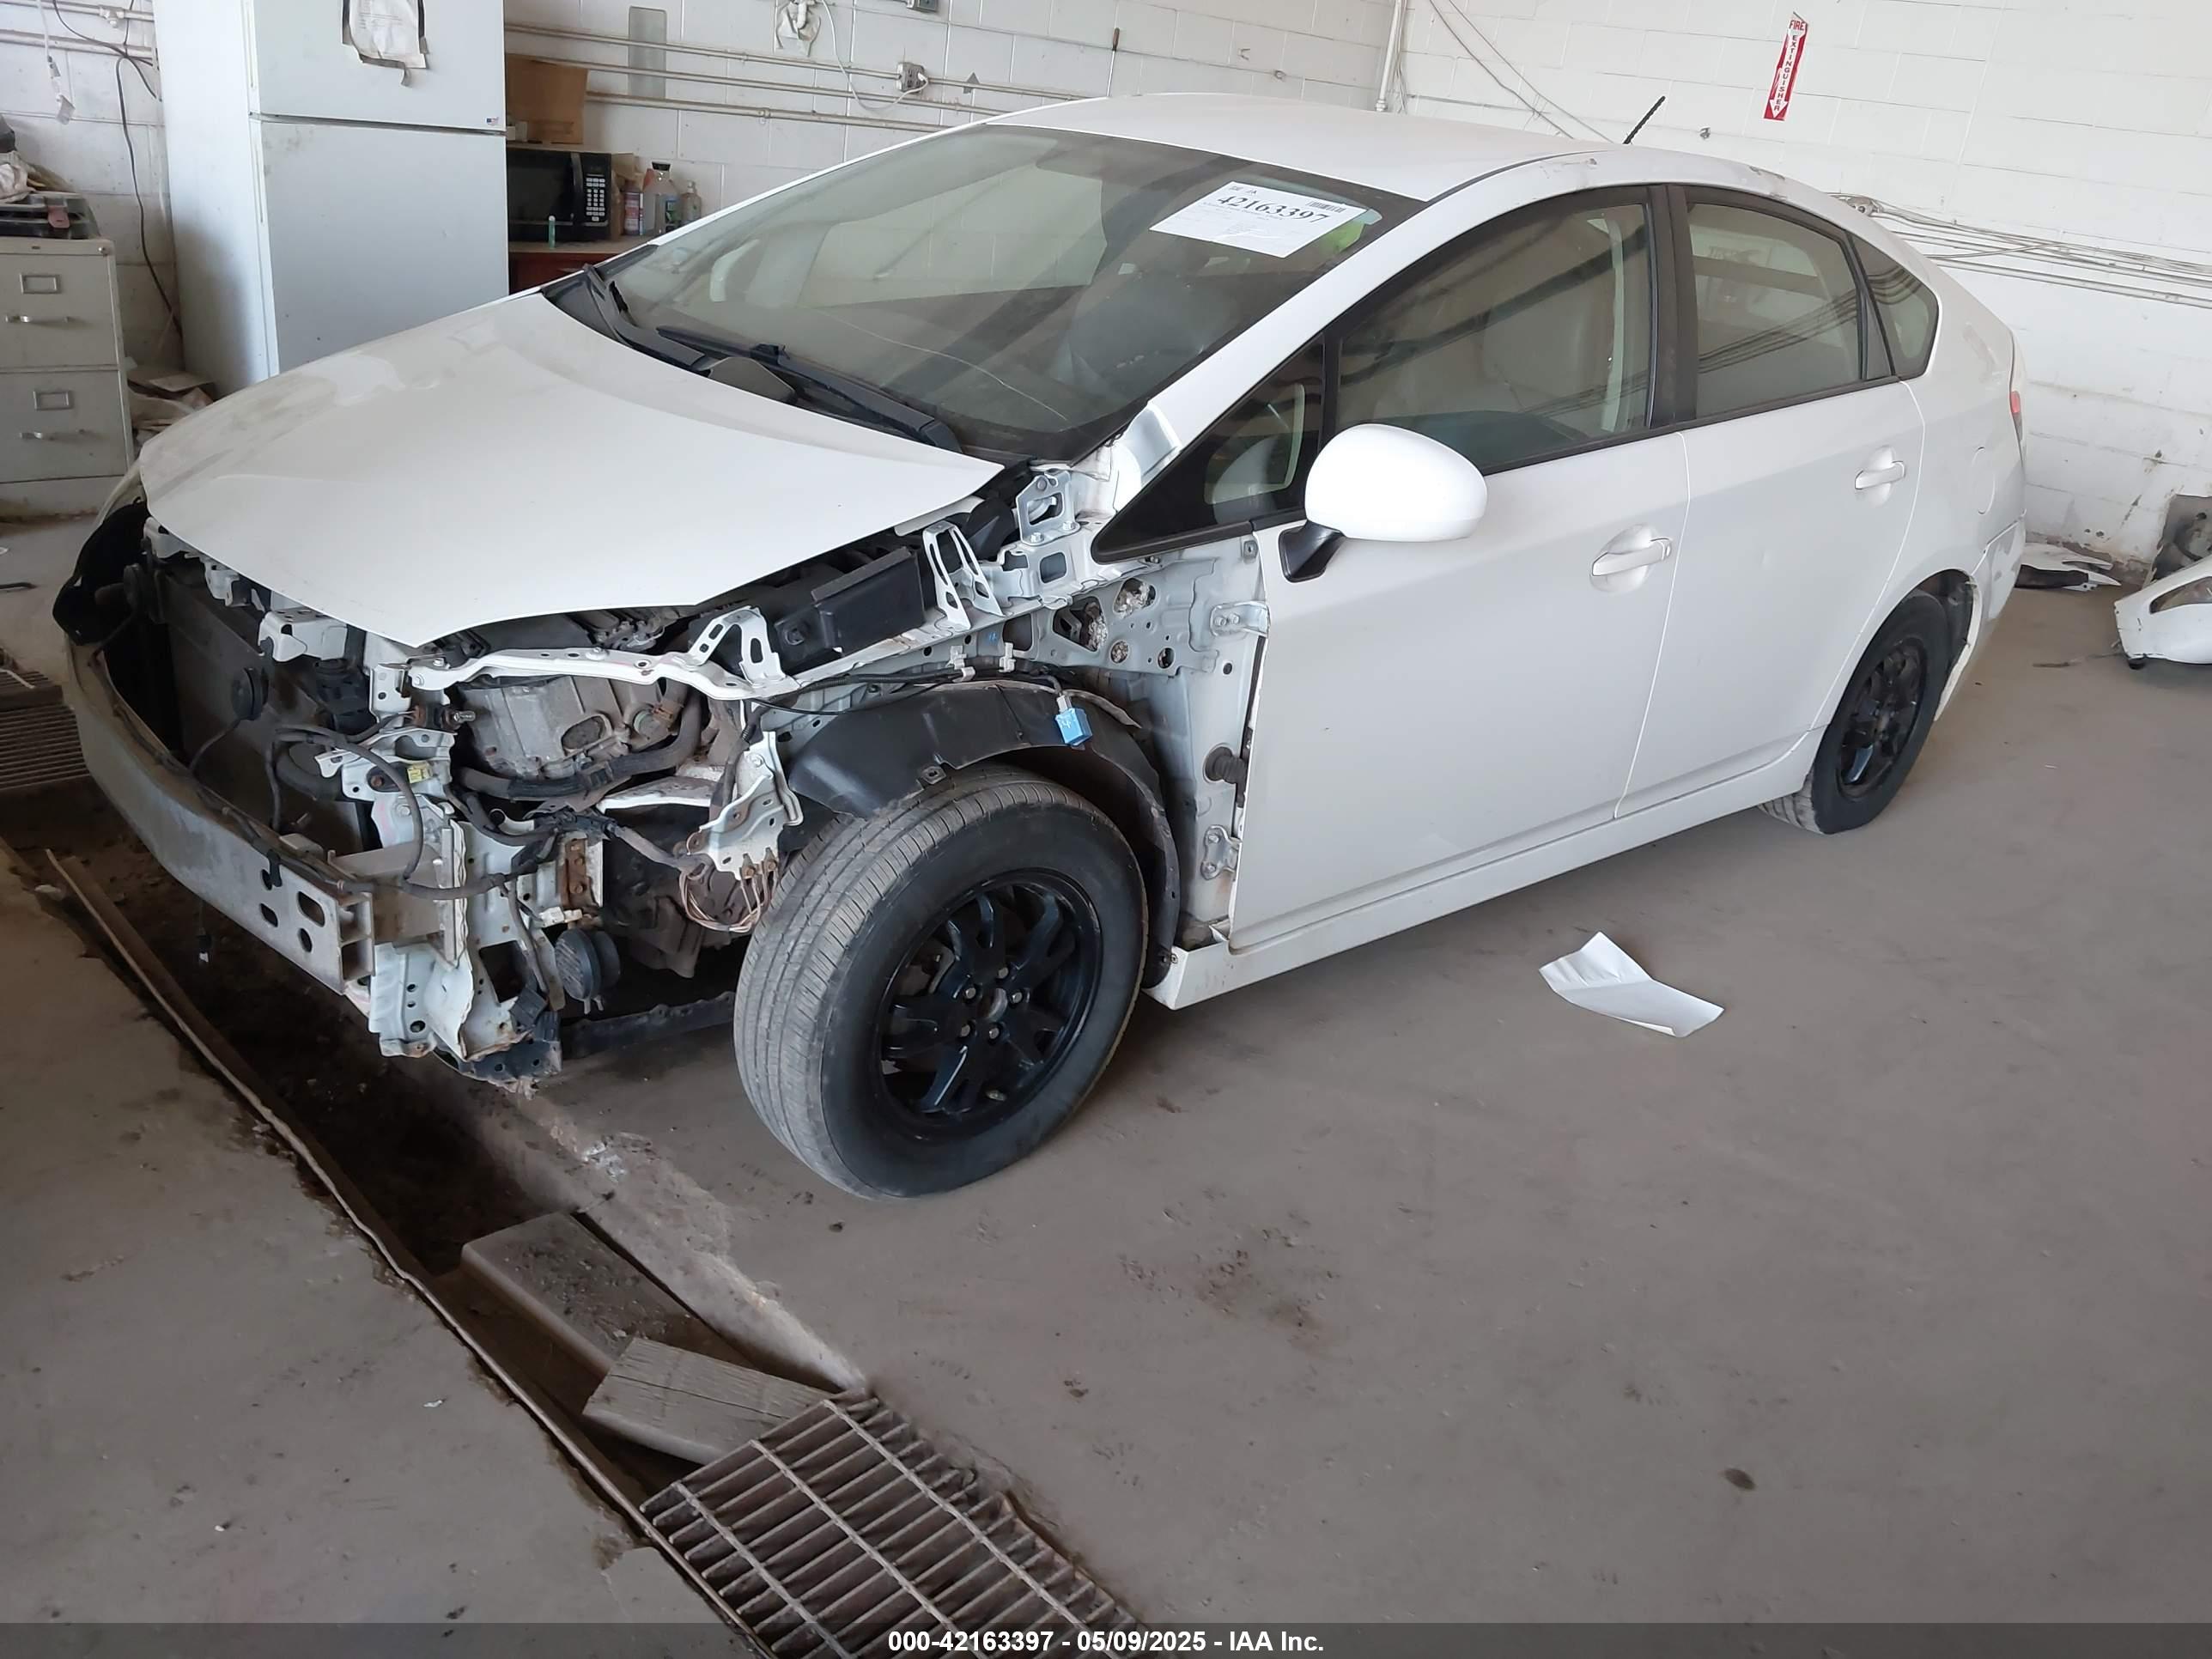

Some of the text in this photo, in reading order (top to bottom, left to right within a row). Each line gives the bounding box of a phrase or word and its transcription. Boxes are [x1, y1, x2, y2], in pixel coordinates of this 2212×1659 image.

[1789, 20, 1805, 31] FIRE
[1773, 34, 1798, 112] EXTINGUISHER
[1217, 195, 1331, 223] 42163397
